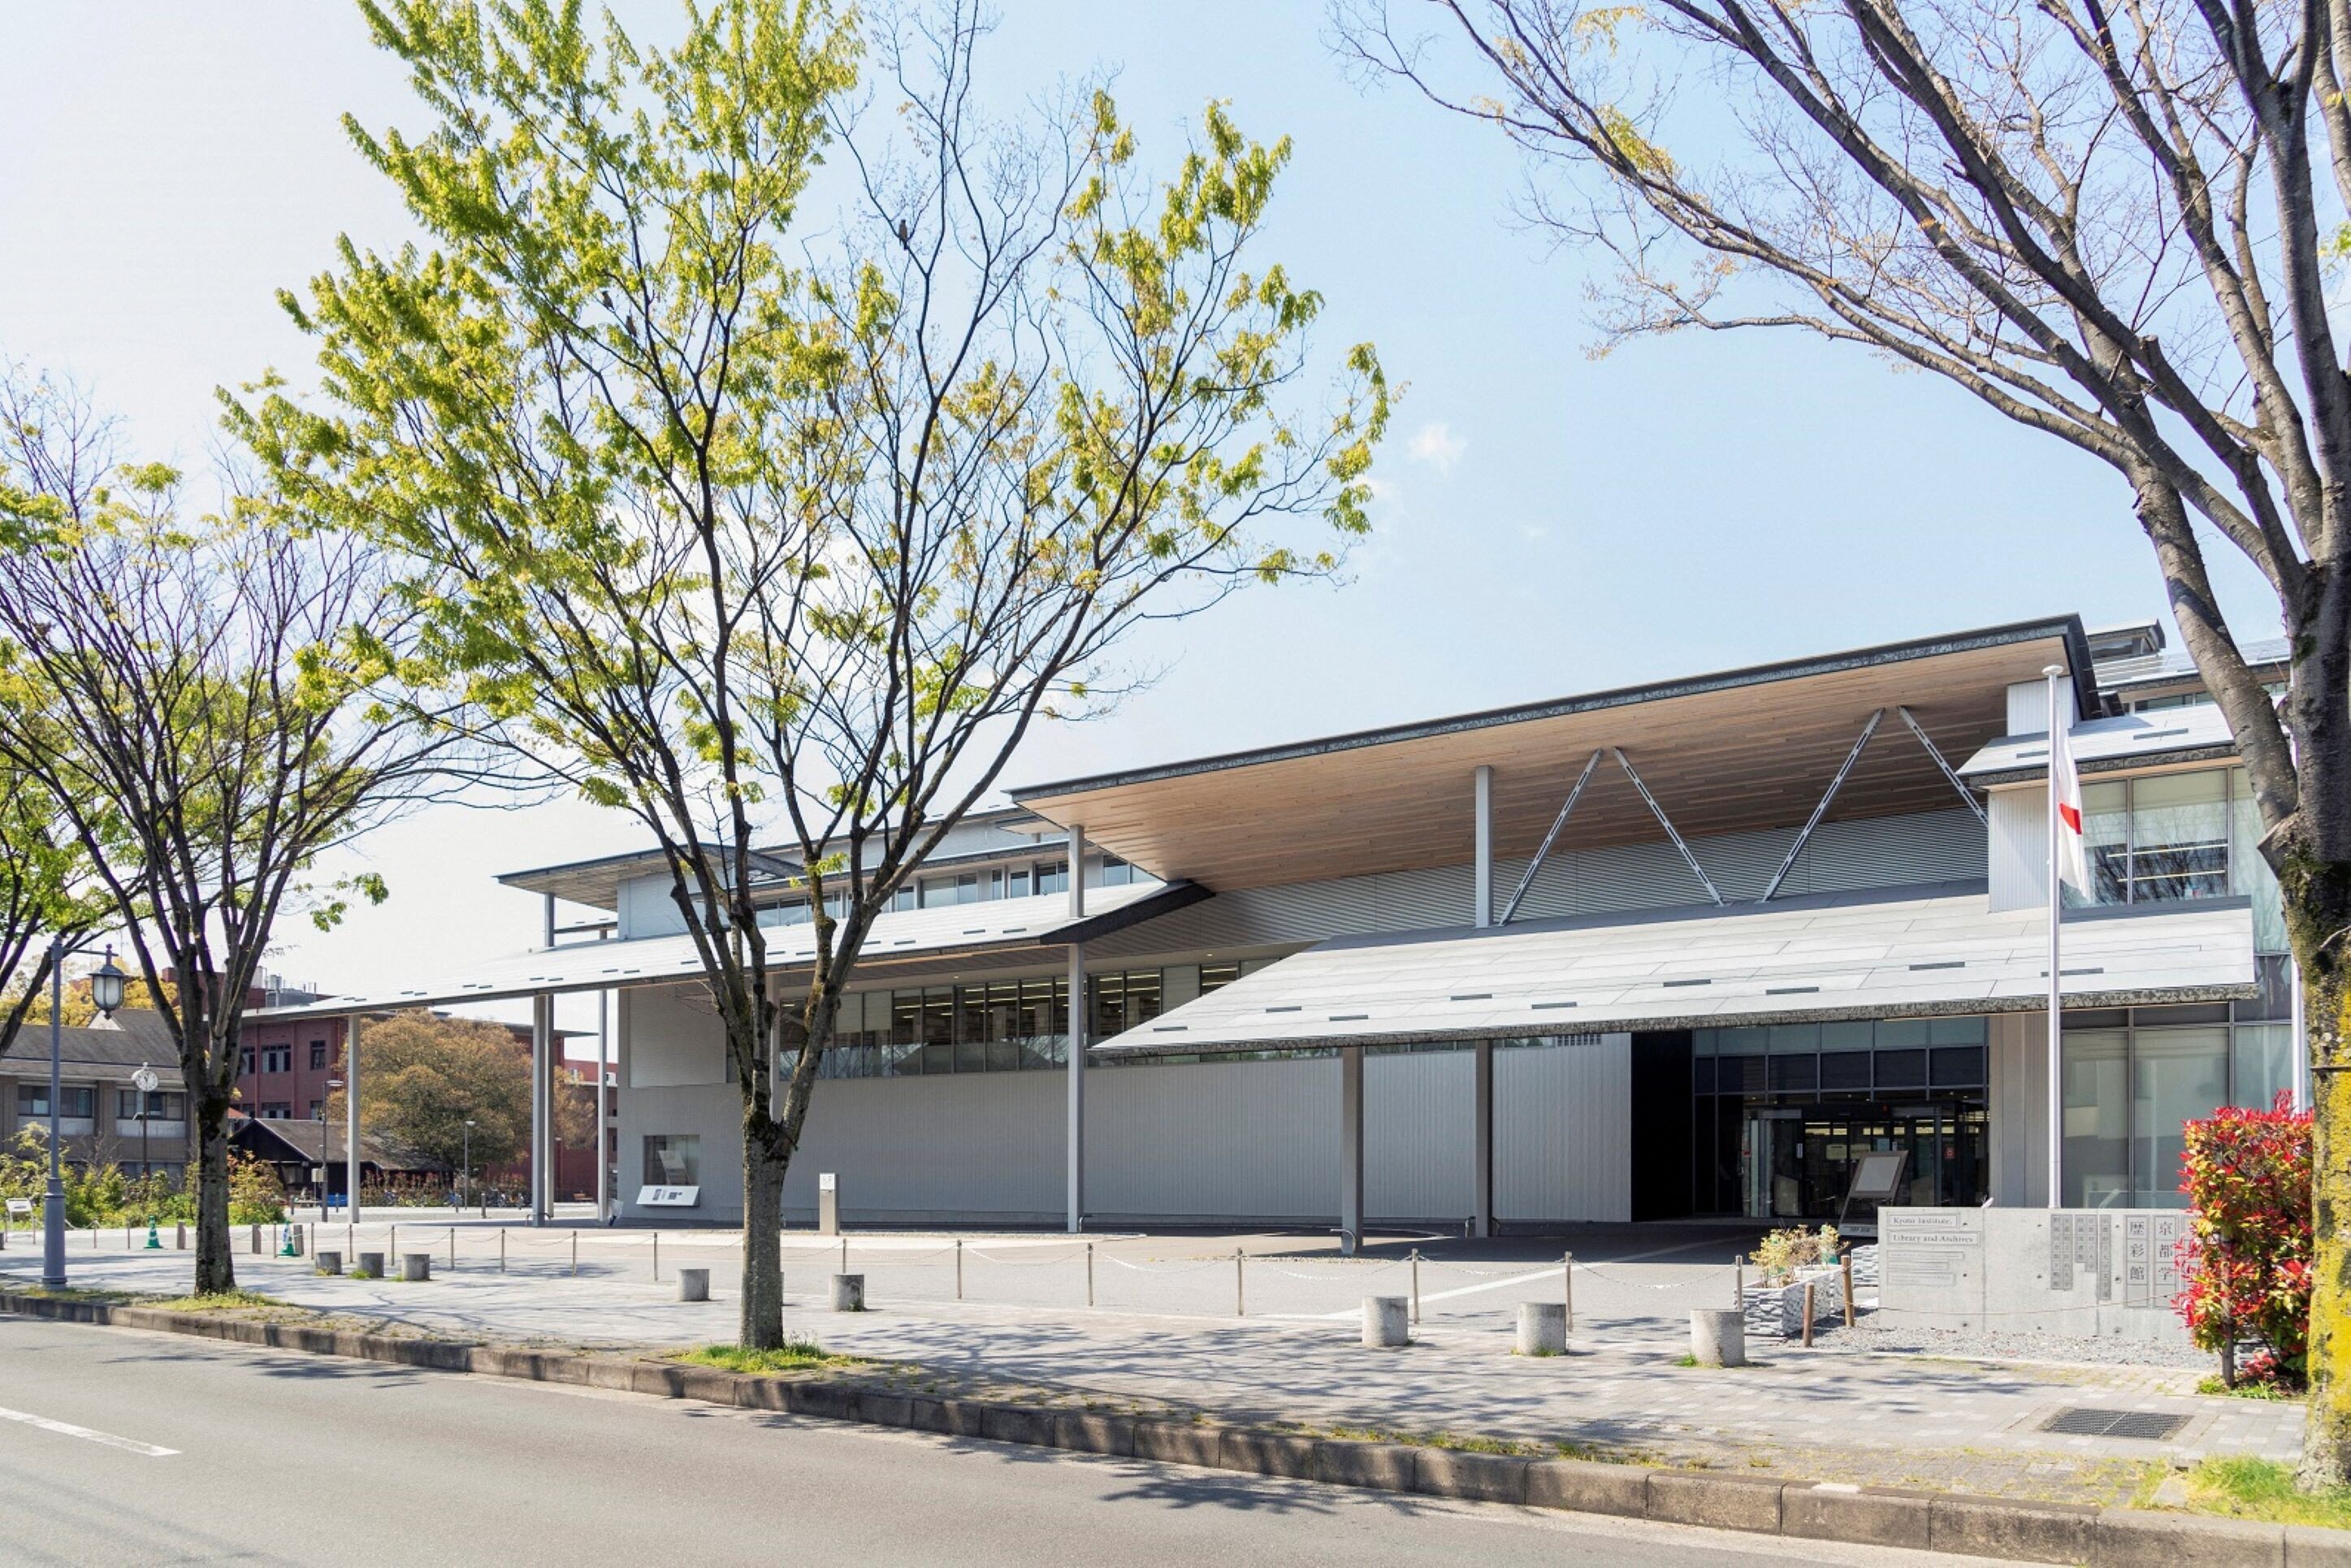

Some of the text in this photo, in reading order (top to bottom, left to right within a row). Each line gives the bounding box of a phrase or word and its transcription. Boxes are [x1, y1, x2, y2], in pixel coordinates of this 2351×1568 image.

[1893, 1217, 1953, 1226] Kyoto Institute,
[1893, 1234, 1973, 1244] Library and Archives
[2130, 1221, 2145, 1280] 歴彩館
[2158, 1221, 2173, 1280] 京都学
